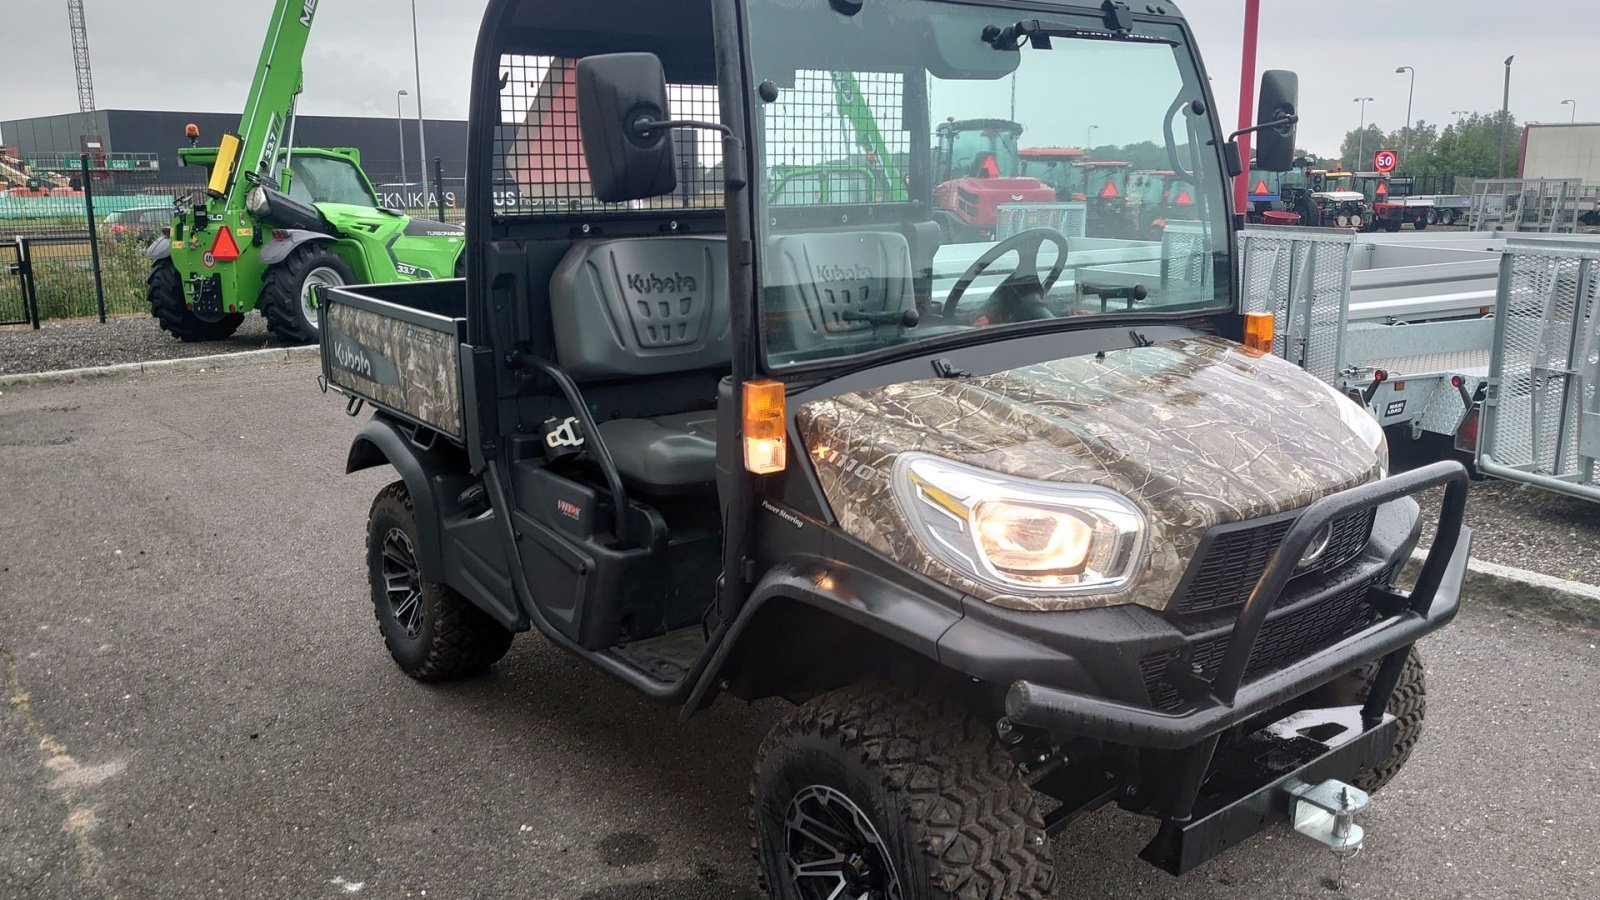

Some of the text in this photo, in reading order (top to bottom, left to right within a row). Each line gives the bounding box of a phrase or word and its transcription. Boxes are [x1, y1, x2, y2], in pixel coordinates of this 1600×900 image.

[265, 132, 276, 158] 33.7
[1378, 156, 1392, 166] 50
[205, 254, 214, 263] 40
[397, 265, 416, 275] 33.7
[816, 263, 873, 282] Kubota
[627, 271, 697, 294] Kubota
[405, 328, 447, 349] DIESEL
[334, 341, 371, 377] Kubota
[762, 500, 804, 528] Power Steering
